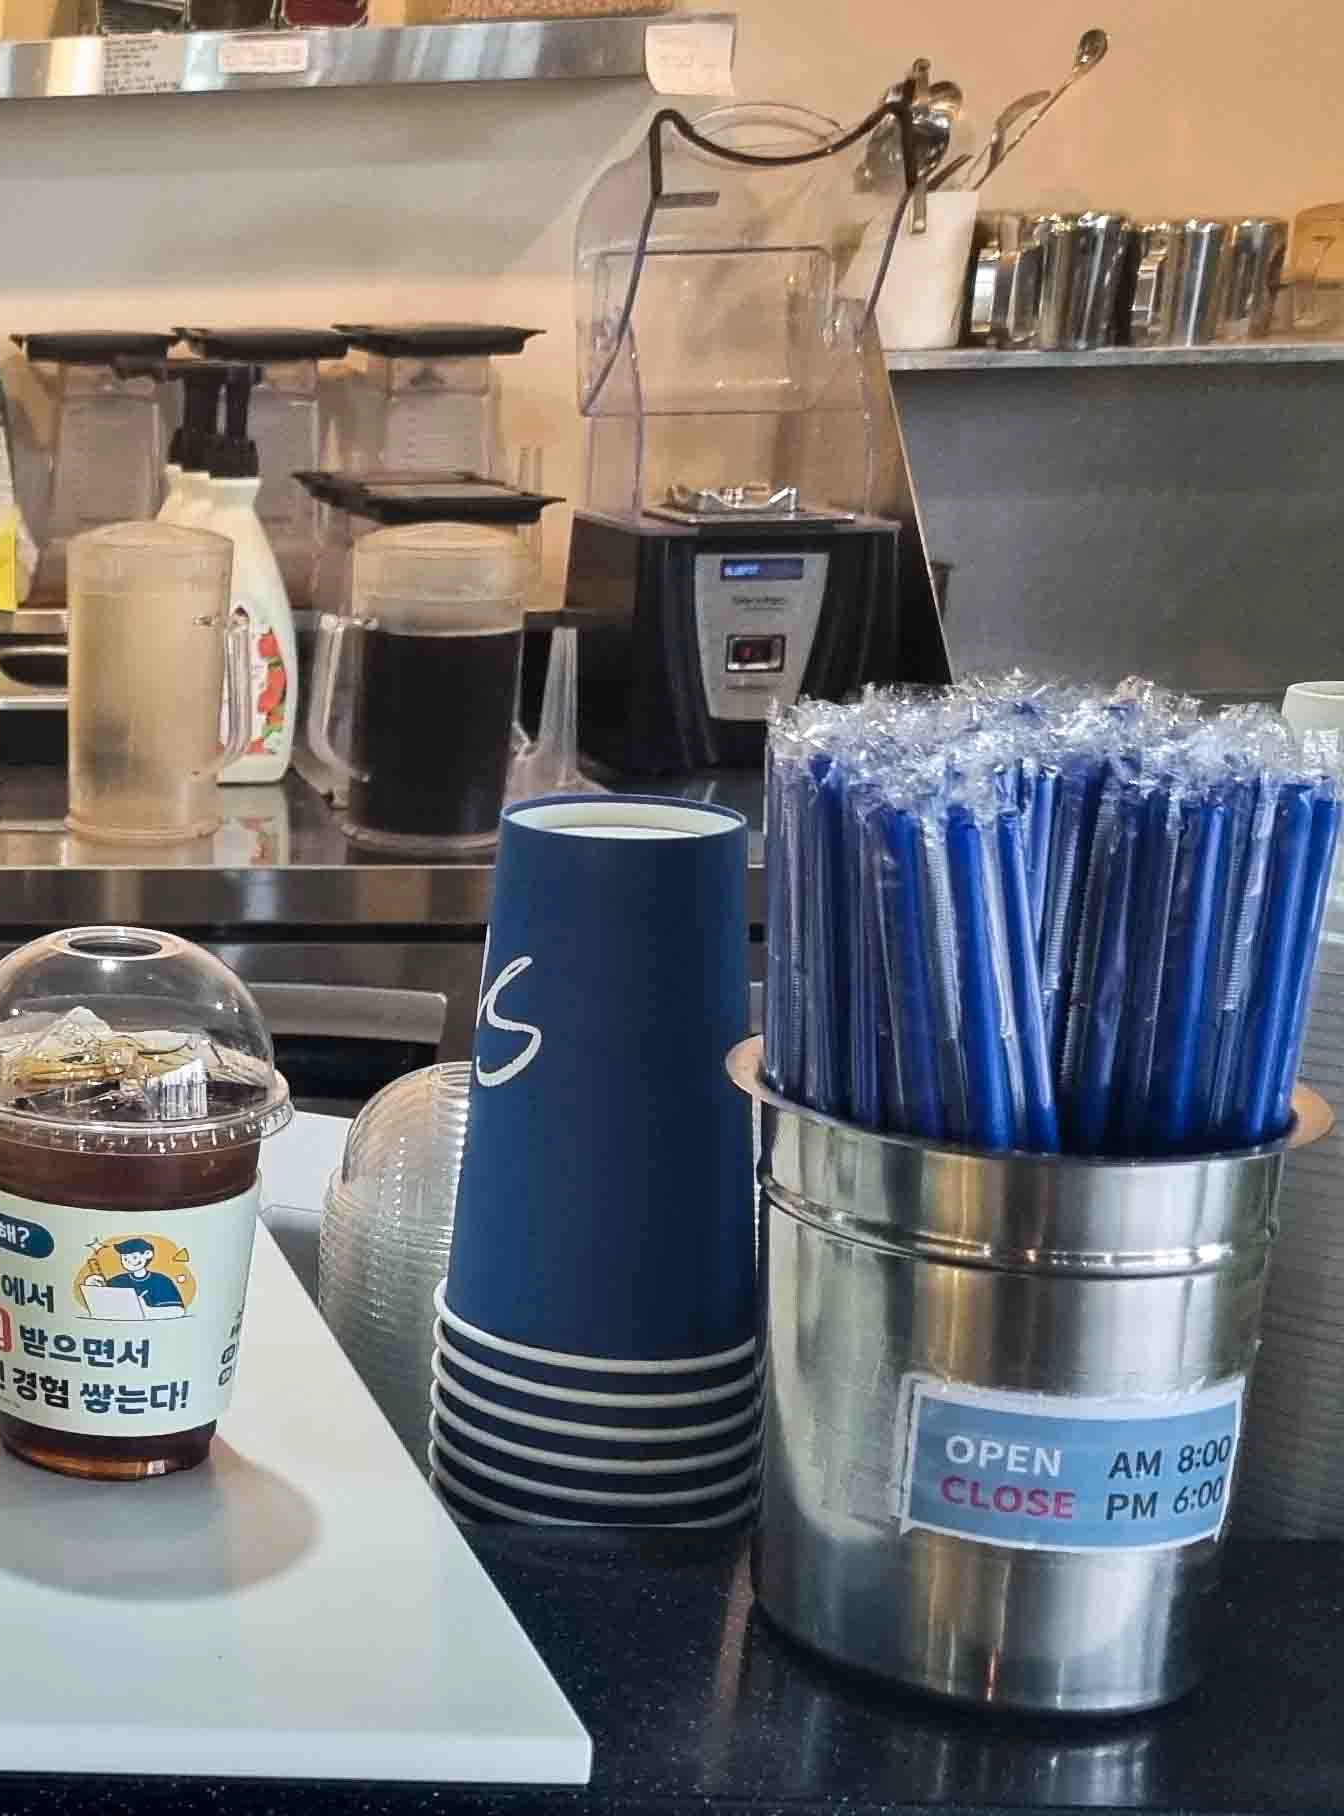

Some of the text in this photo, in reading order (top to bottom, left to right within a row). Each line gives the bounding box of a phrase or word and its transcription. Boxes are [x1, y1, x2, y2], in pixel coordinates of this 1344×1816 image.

[1, 1274, 56, 1314] 에서
[18, 1324, 150, 1369] 받으면서
[12, 1367, 70, 1410] 경험
[80, 1380, 190, 1415] 쌓는다!
[943, 1434, 1232, 1481] OPEN AM 8:00
[940, 1474, 1224, 1521] CLOSE PM 6:00
